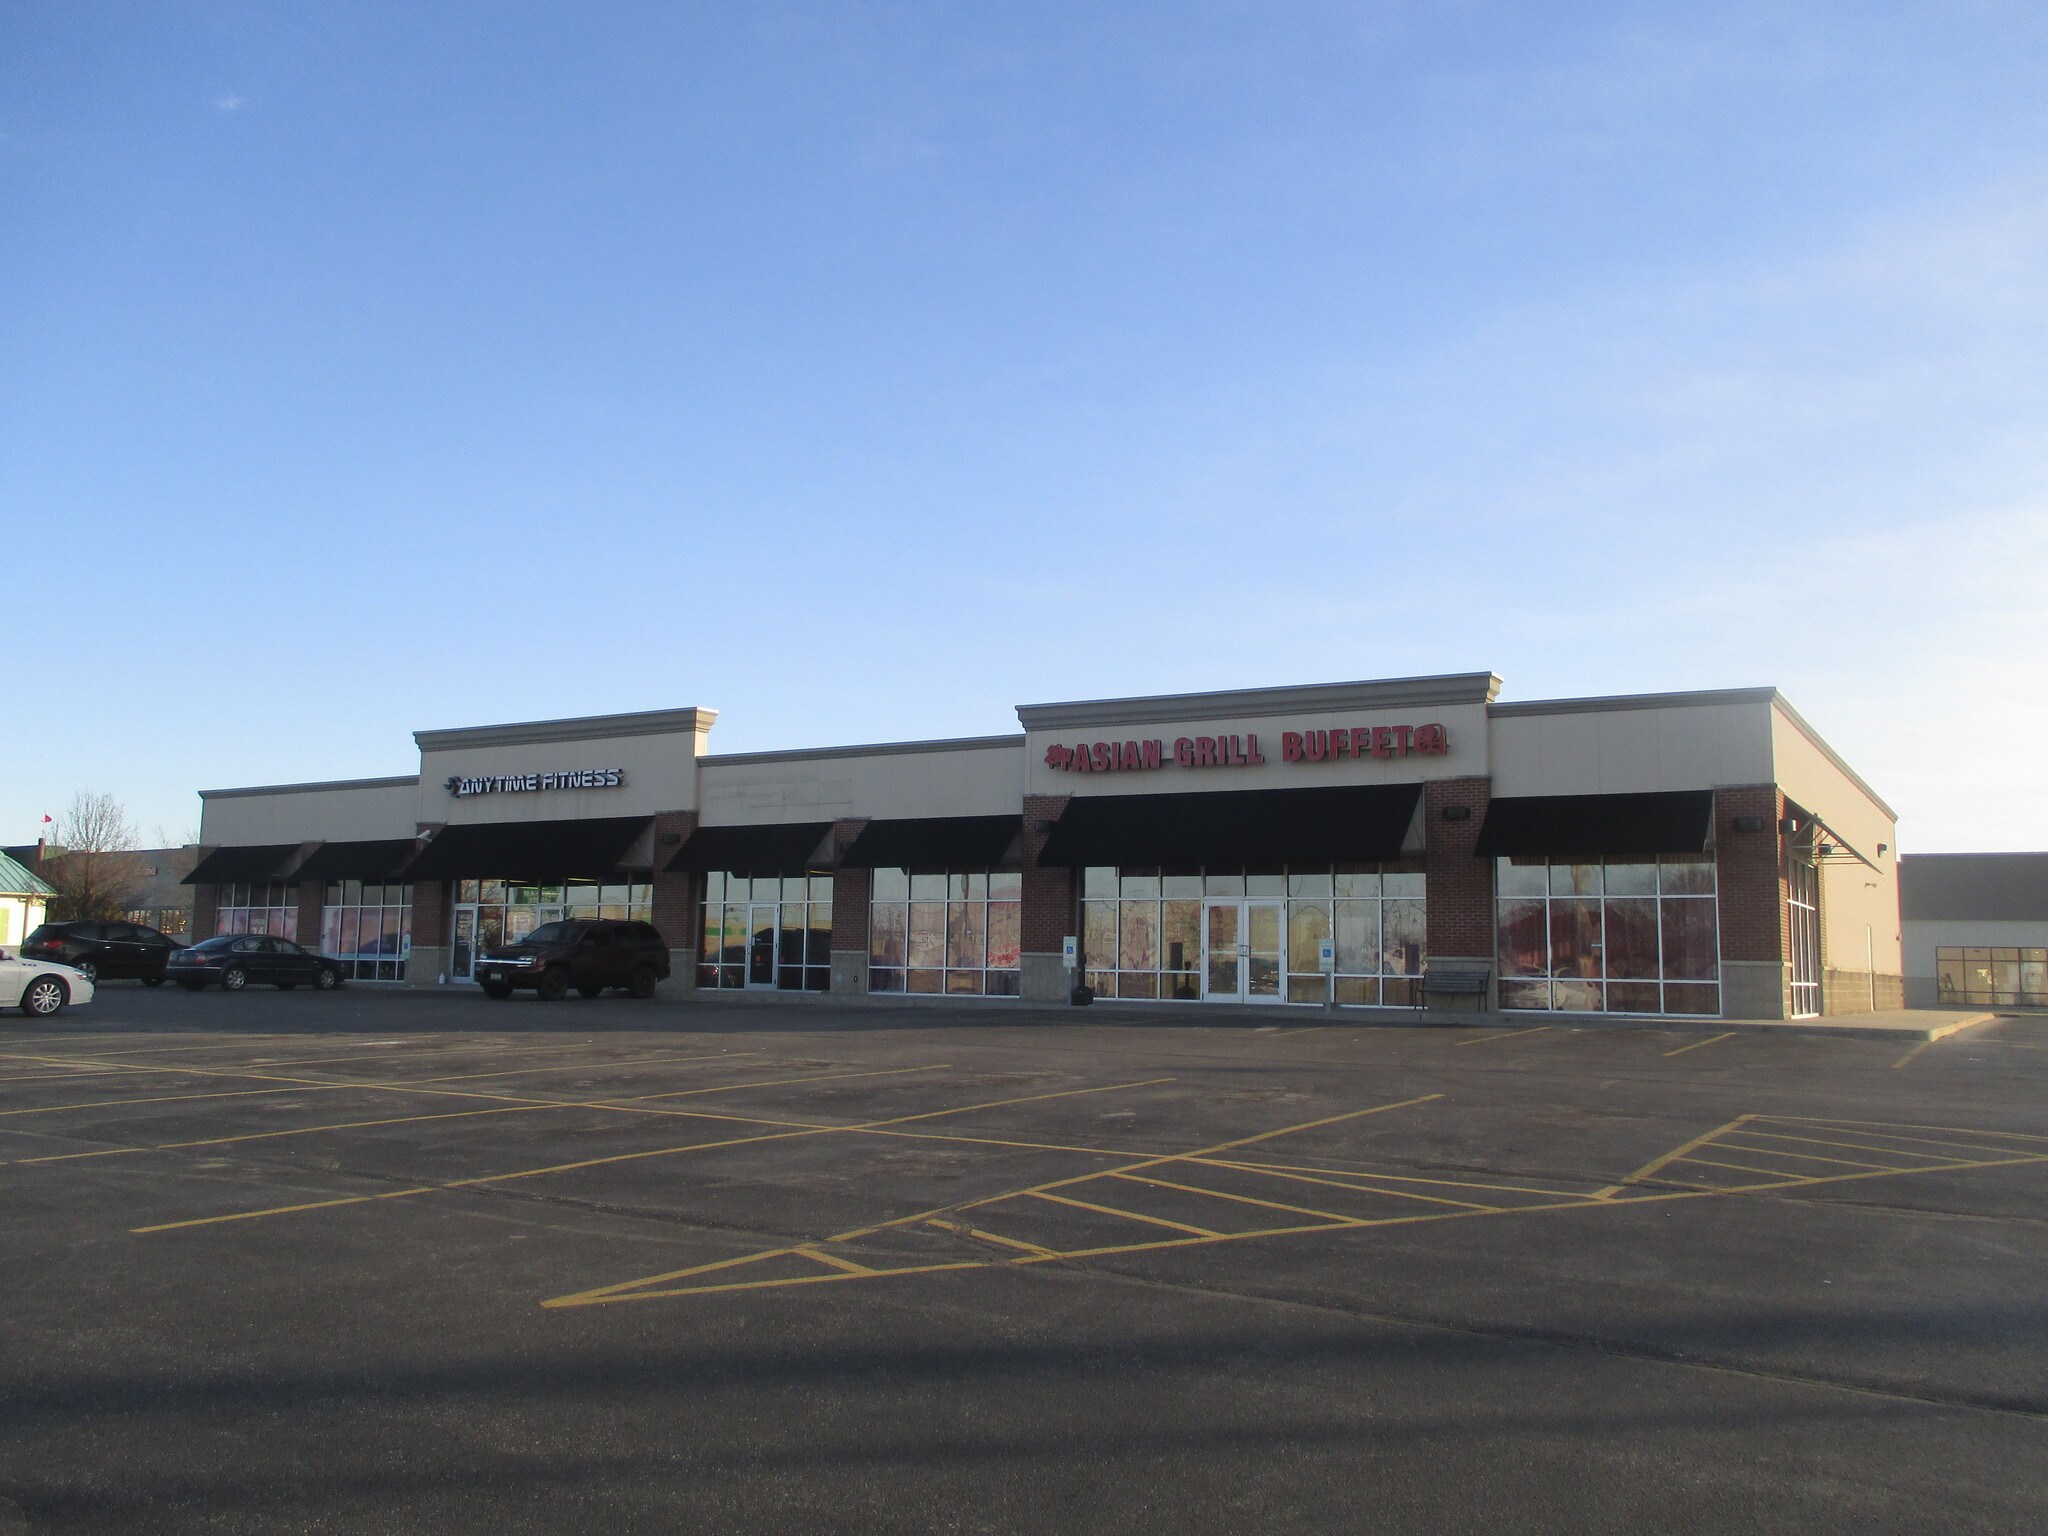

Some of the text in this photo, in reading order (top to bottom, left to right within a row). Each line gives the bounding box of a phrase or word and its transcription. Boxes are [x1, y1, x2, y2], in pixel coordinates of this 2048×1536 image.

[1072, 725, 1413, 771] ASIAN GRILL BUFFET
[460, 769, 621, 794] ANYTIME FITNESS
